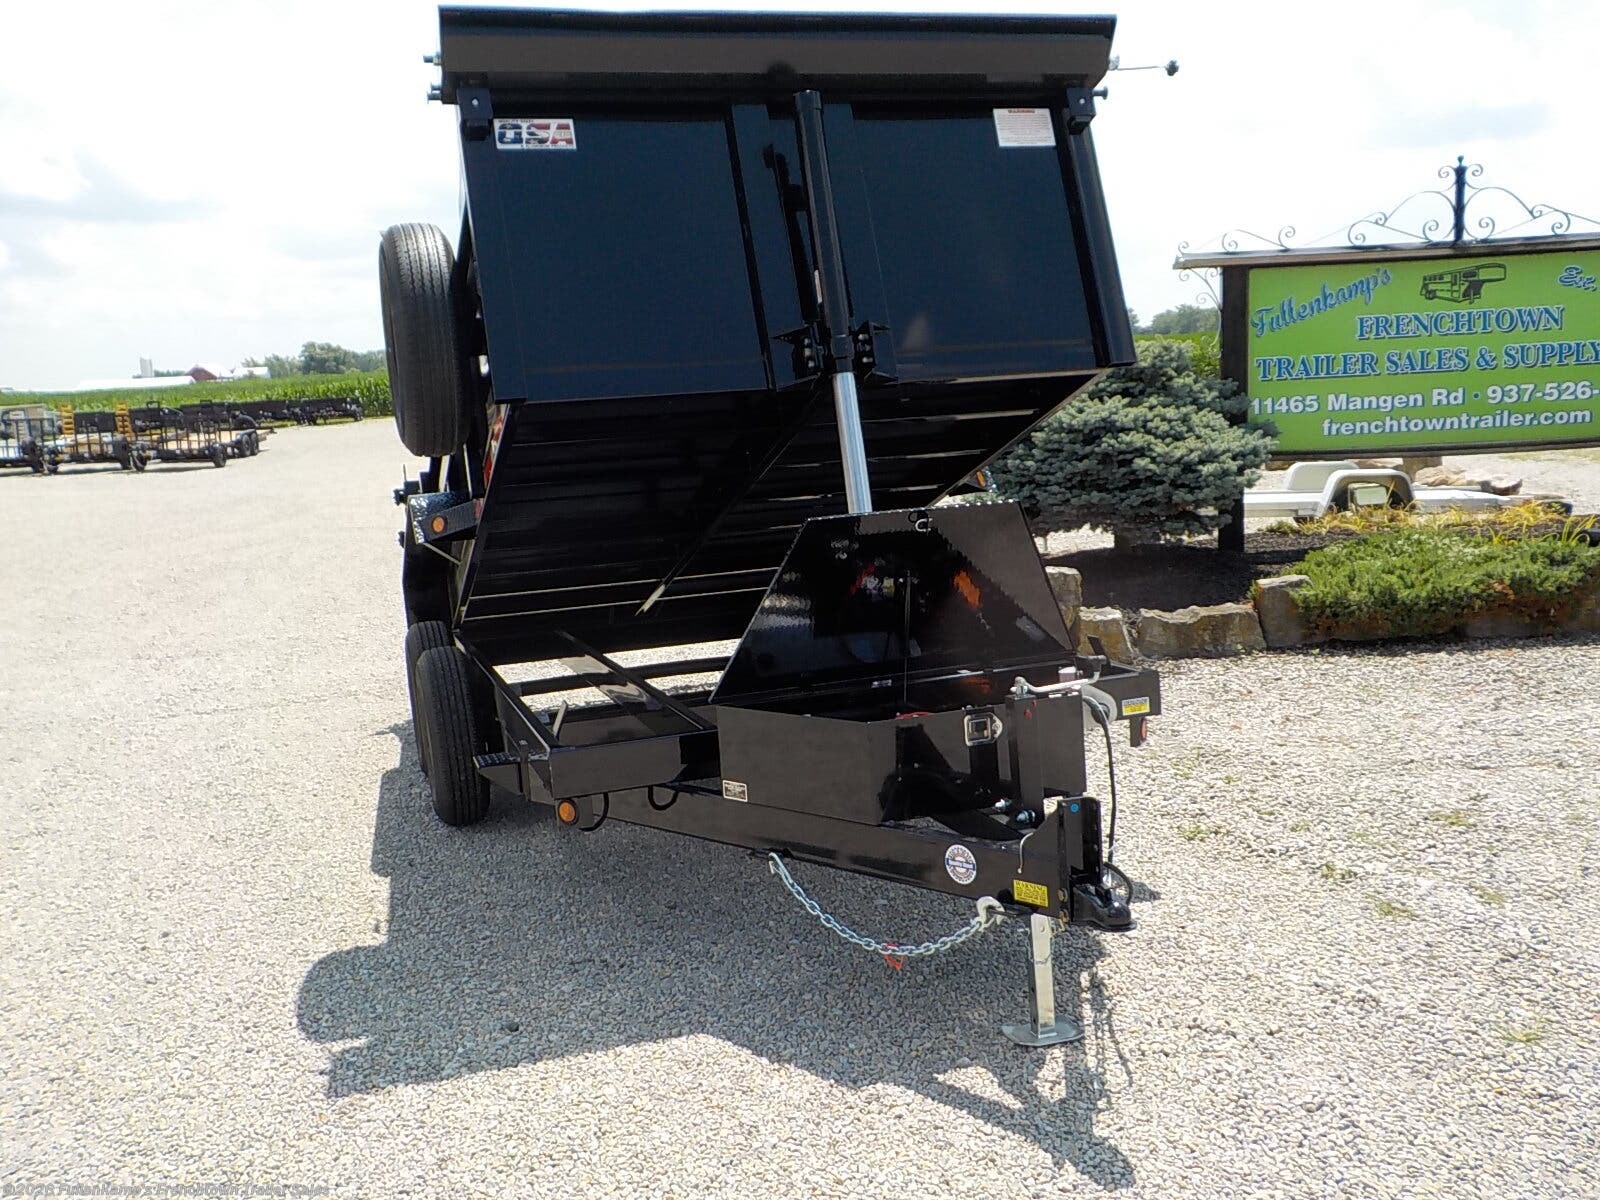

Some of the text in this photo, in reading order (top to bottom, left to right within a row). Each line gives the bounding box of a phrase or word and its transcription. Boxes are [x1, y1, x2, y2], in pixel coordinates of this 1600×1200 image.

[1251, 267, 1393, 337] Fullenkamp's
[1356, 305, 1565, 340] FRENCHTOWN
[1255, 352, 1381, 382] TRAILER
[1385, 347, 1469, 375] SALES
[1475, 346, 1497, 370] &
[1251, 395, 1319, 415] 11465
[1327, 392, 1424, 412] Mangen
[1432, 387, 1464, 406] Rd
[1322, 409, 1592, 437] frenchtowntrailer.com
